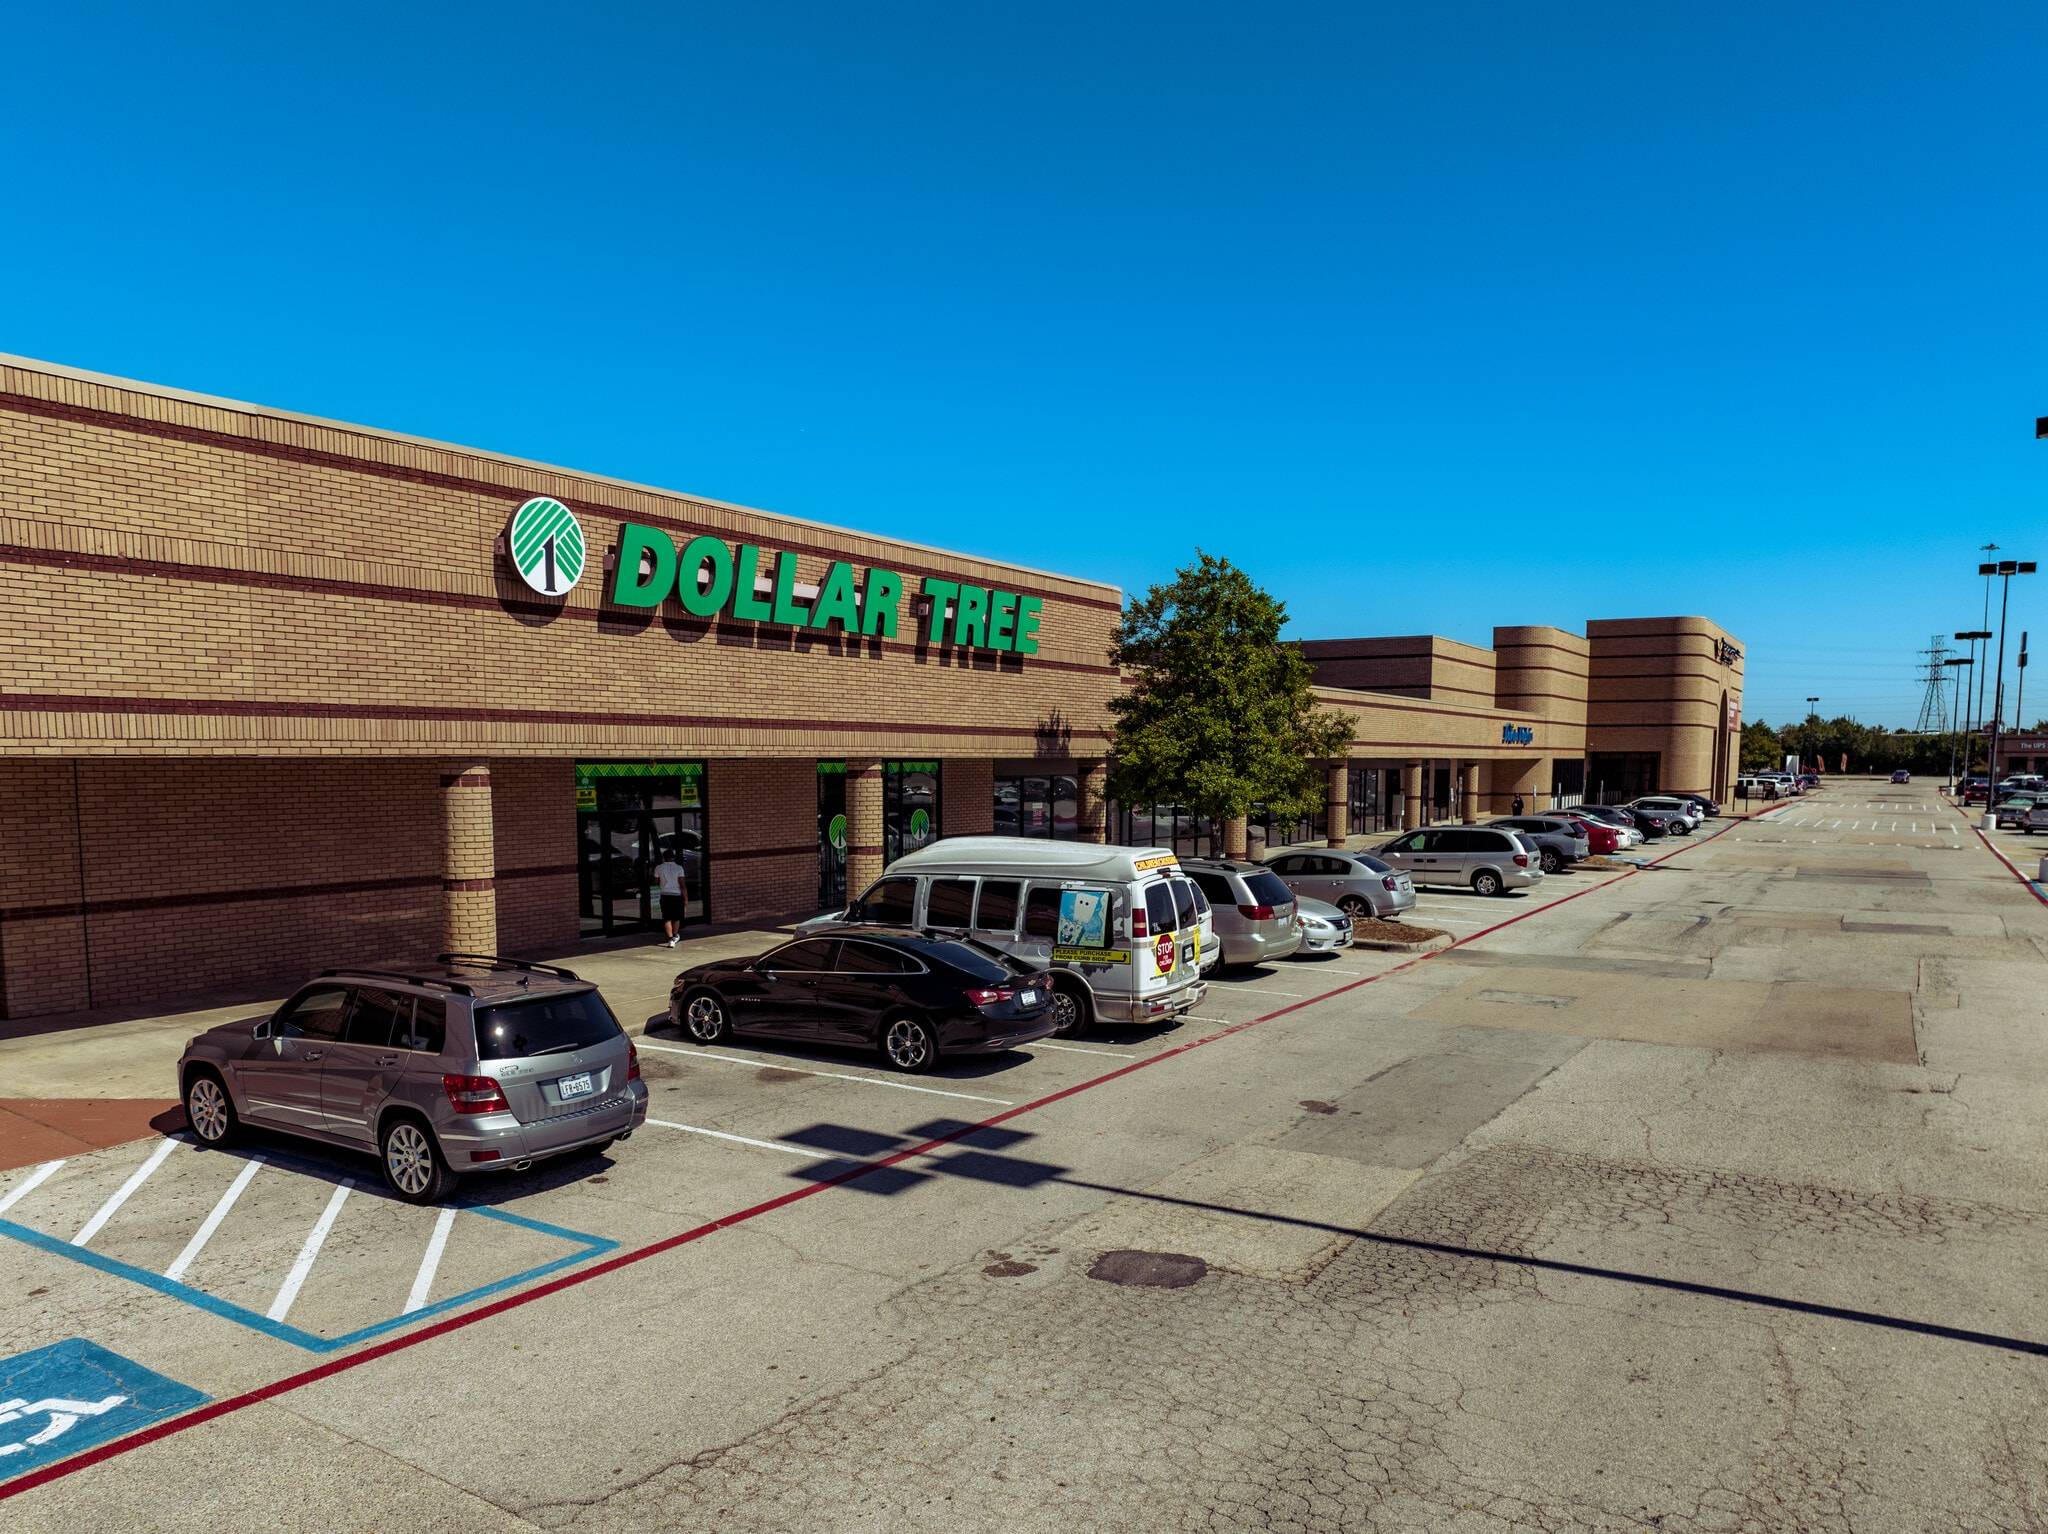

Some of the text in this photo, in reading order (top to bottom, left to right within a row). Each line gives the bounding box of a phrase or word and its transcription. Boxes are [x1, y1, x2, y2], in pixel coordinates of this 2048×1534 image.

[611, 522, 1044, 654] DOLLAR TREE
[1157, 941, 1173, 956] STOP
